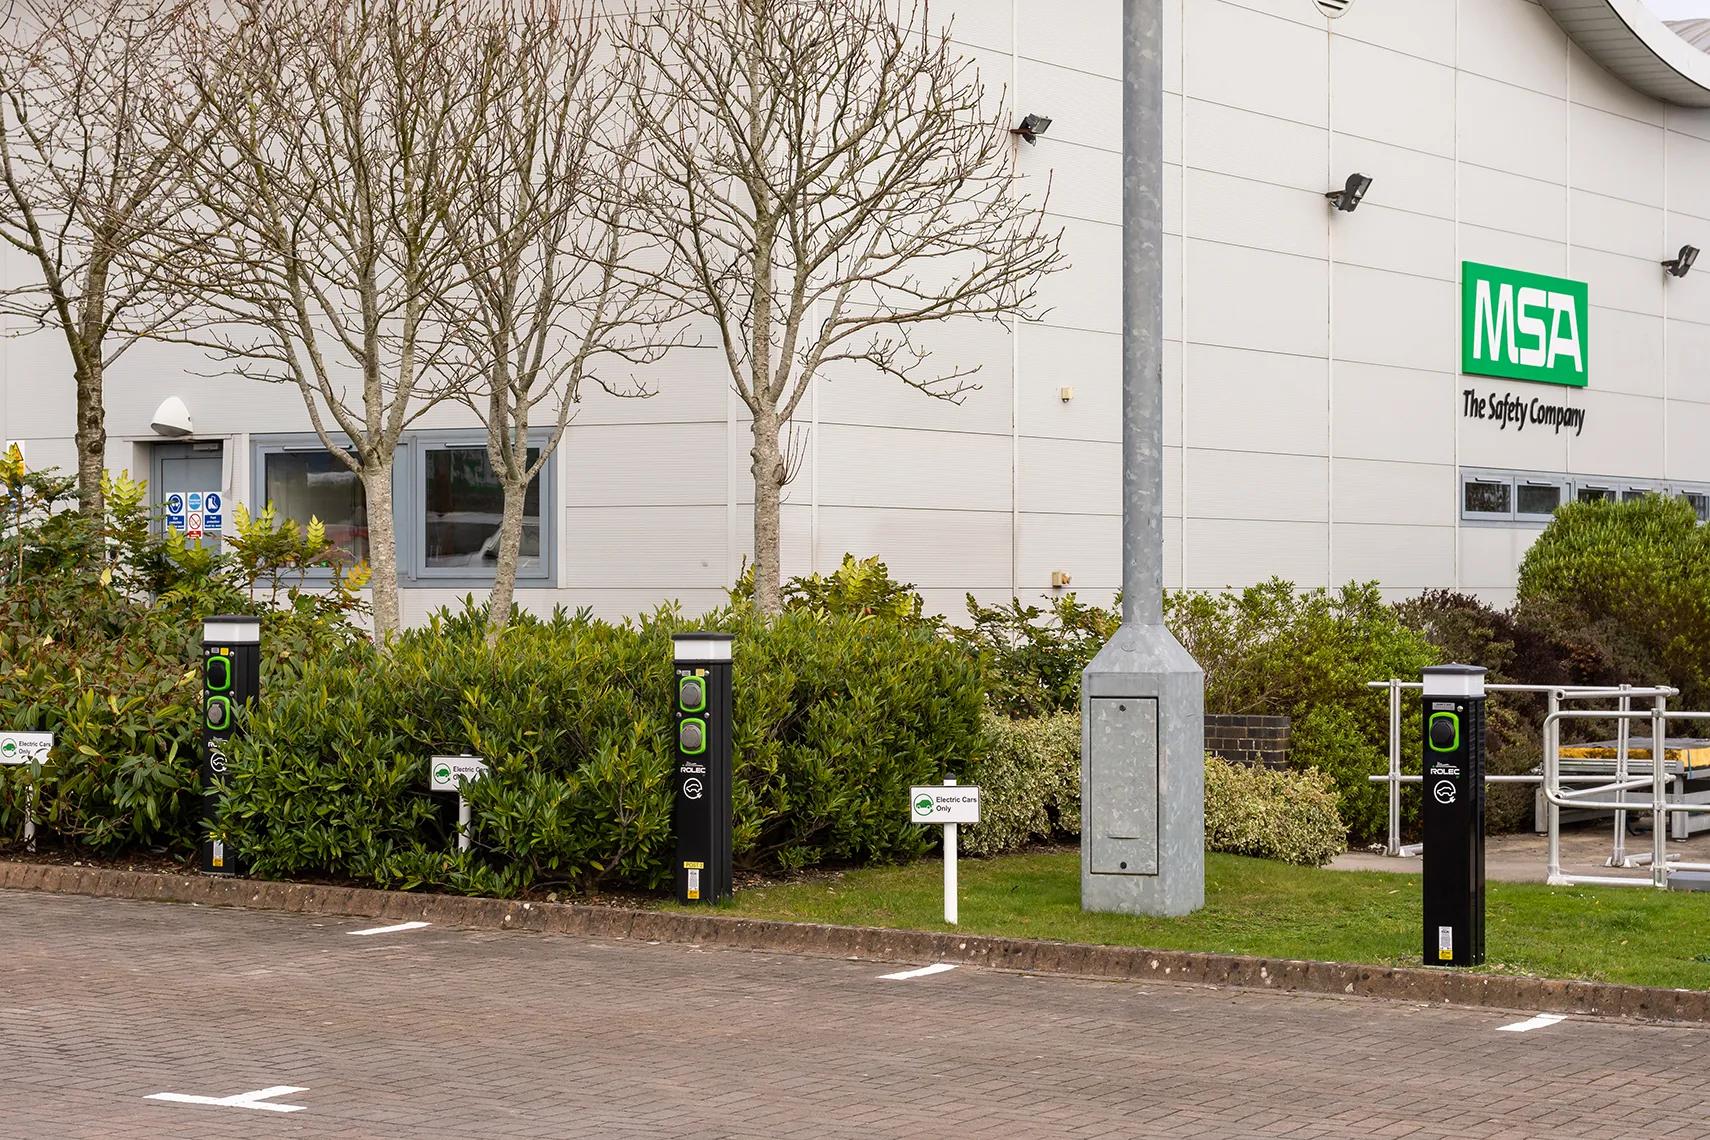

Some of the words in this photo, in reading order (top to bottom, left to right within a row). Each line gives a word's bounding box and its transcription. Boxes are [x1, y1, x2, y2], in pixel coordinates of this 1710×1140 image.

[1472, 279, 1583, 373] MSA
[1462, 388, 1486, 419] The
[1488, 392, 1528, 431] Safety
[1530, 397, 1586, 437] Company
[935, 804, 952, 813] Only
